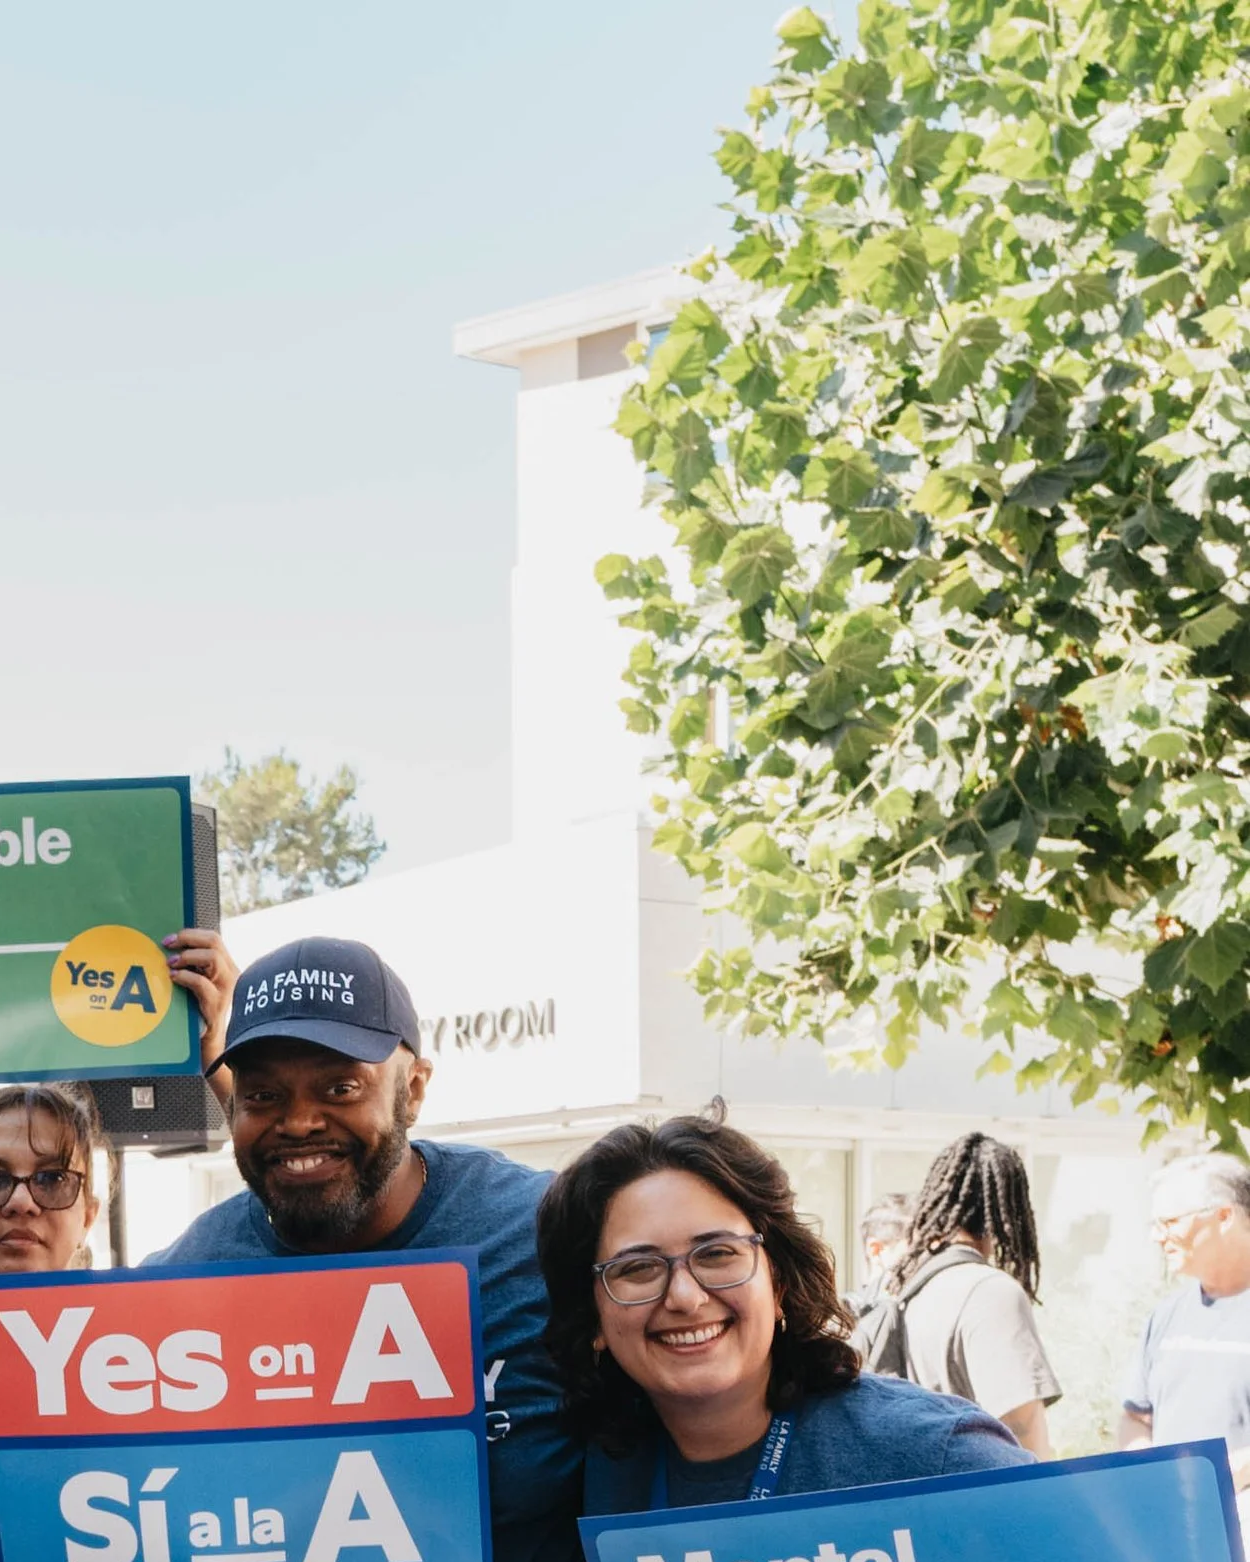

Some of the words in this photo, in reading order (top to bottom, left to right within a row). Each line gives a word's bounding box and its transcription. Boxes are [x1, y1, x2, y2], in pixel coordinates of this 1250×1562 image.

[66, 961, 115, 989] Yes
[111, 966, 157, 1014] A
[247, 980, 268, 1000] LA
[273, 968, 354, 989] FAMILY
[90, 994, 107, 1004] on
[244, 987, 354, 1016] HOUSING
[454, 998, 556, 1053] ROOM
[248, 1343, 316, 1378] on
[331, 1283, 454, 1405] A
[760, 1419, 781, 1471] HOUSING
[779, 1421, 791, 1435] LA
[769, 1436, 787, 1474] FAMILY
[189, 1512, 222, 1548] a
[234, 1498, 286, 1546] la
